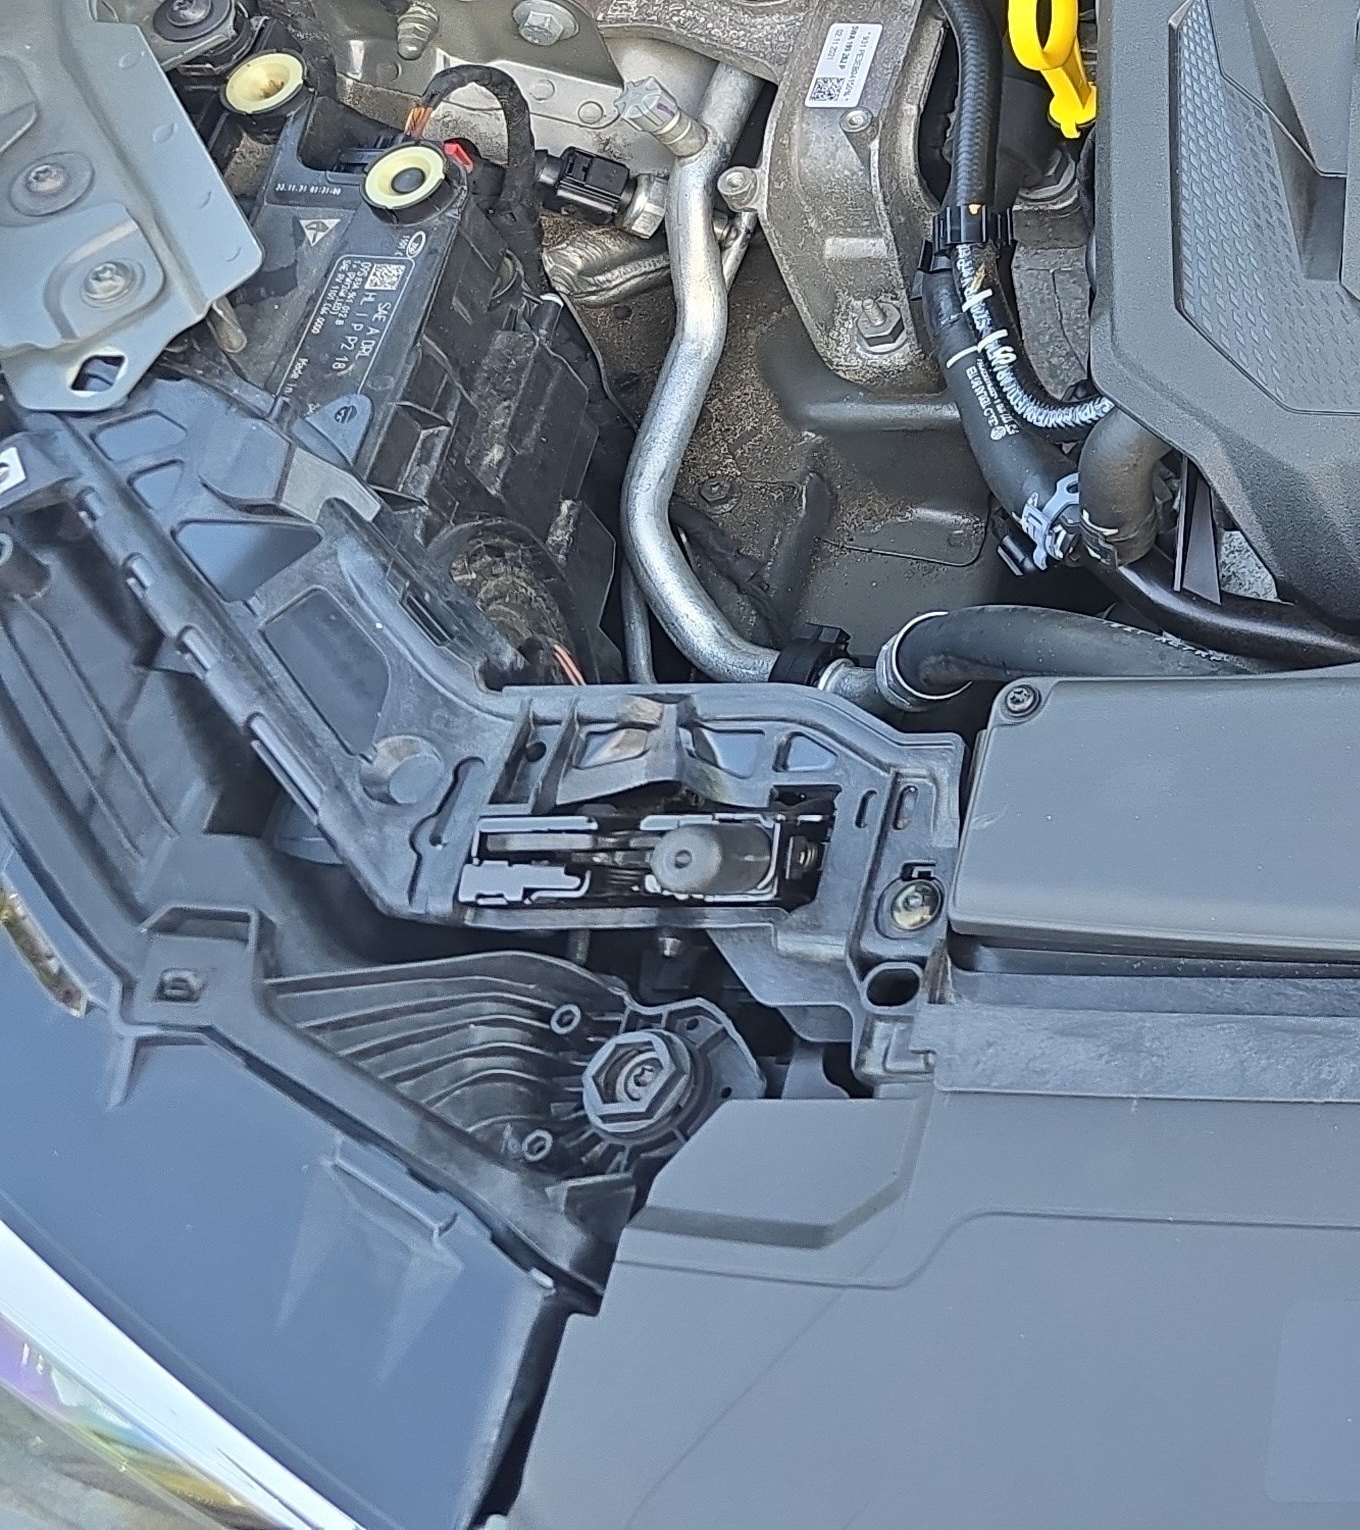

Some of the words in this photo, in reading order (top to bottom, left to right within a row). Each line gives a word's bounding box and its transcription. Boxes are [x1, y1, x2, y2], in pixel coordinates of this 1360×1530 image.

[360, 292, 377, 306] HL
[372, 302, 391, 323] SAE
[352, 323, 364, 332] P
[366, 326, 380, 336] A
[341, 335, 358, 351] P2
[332, 356, 349, 370] 18
